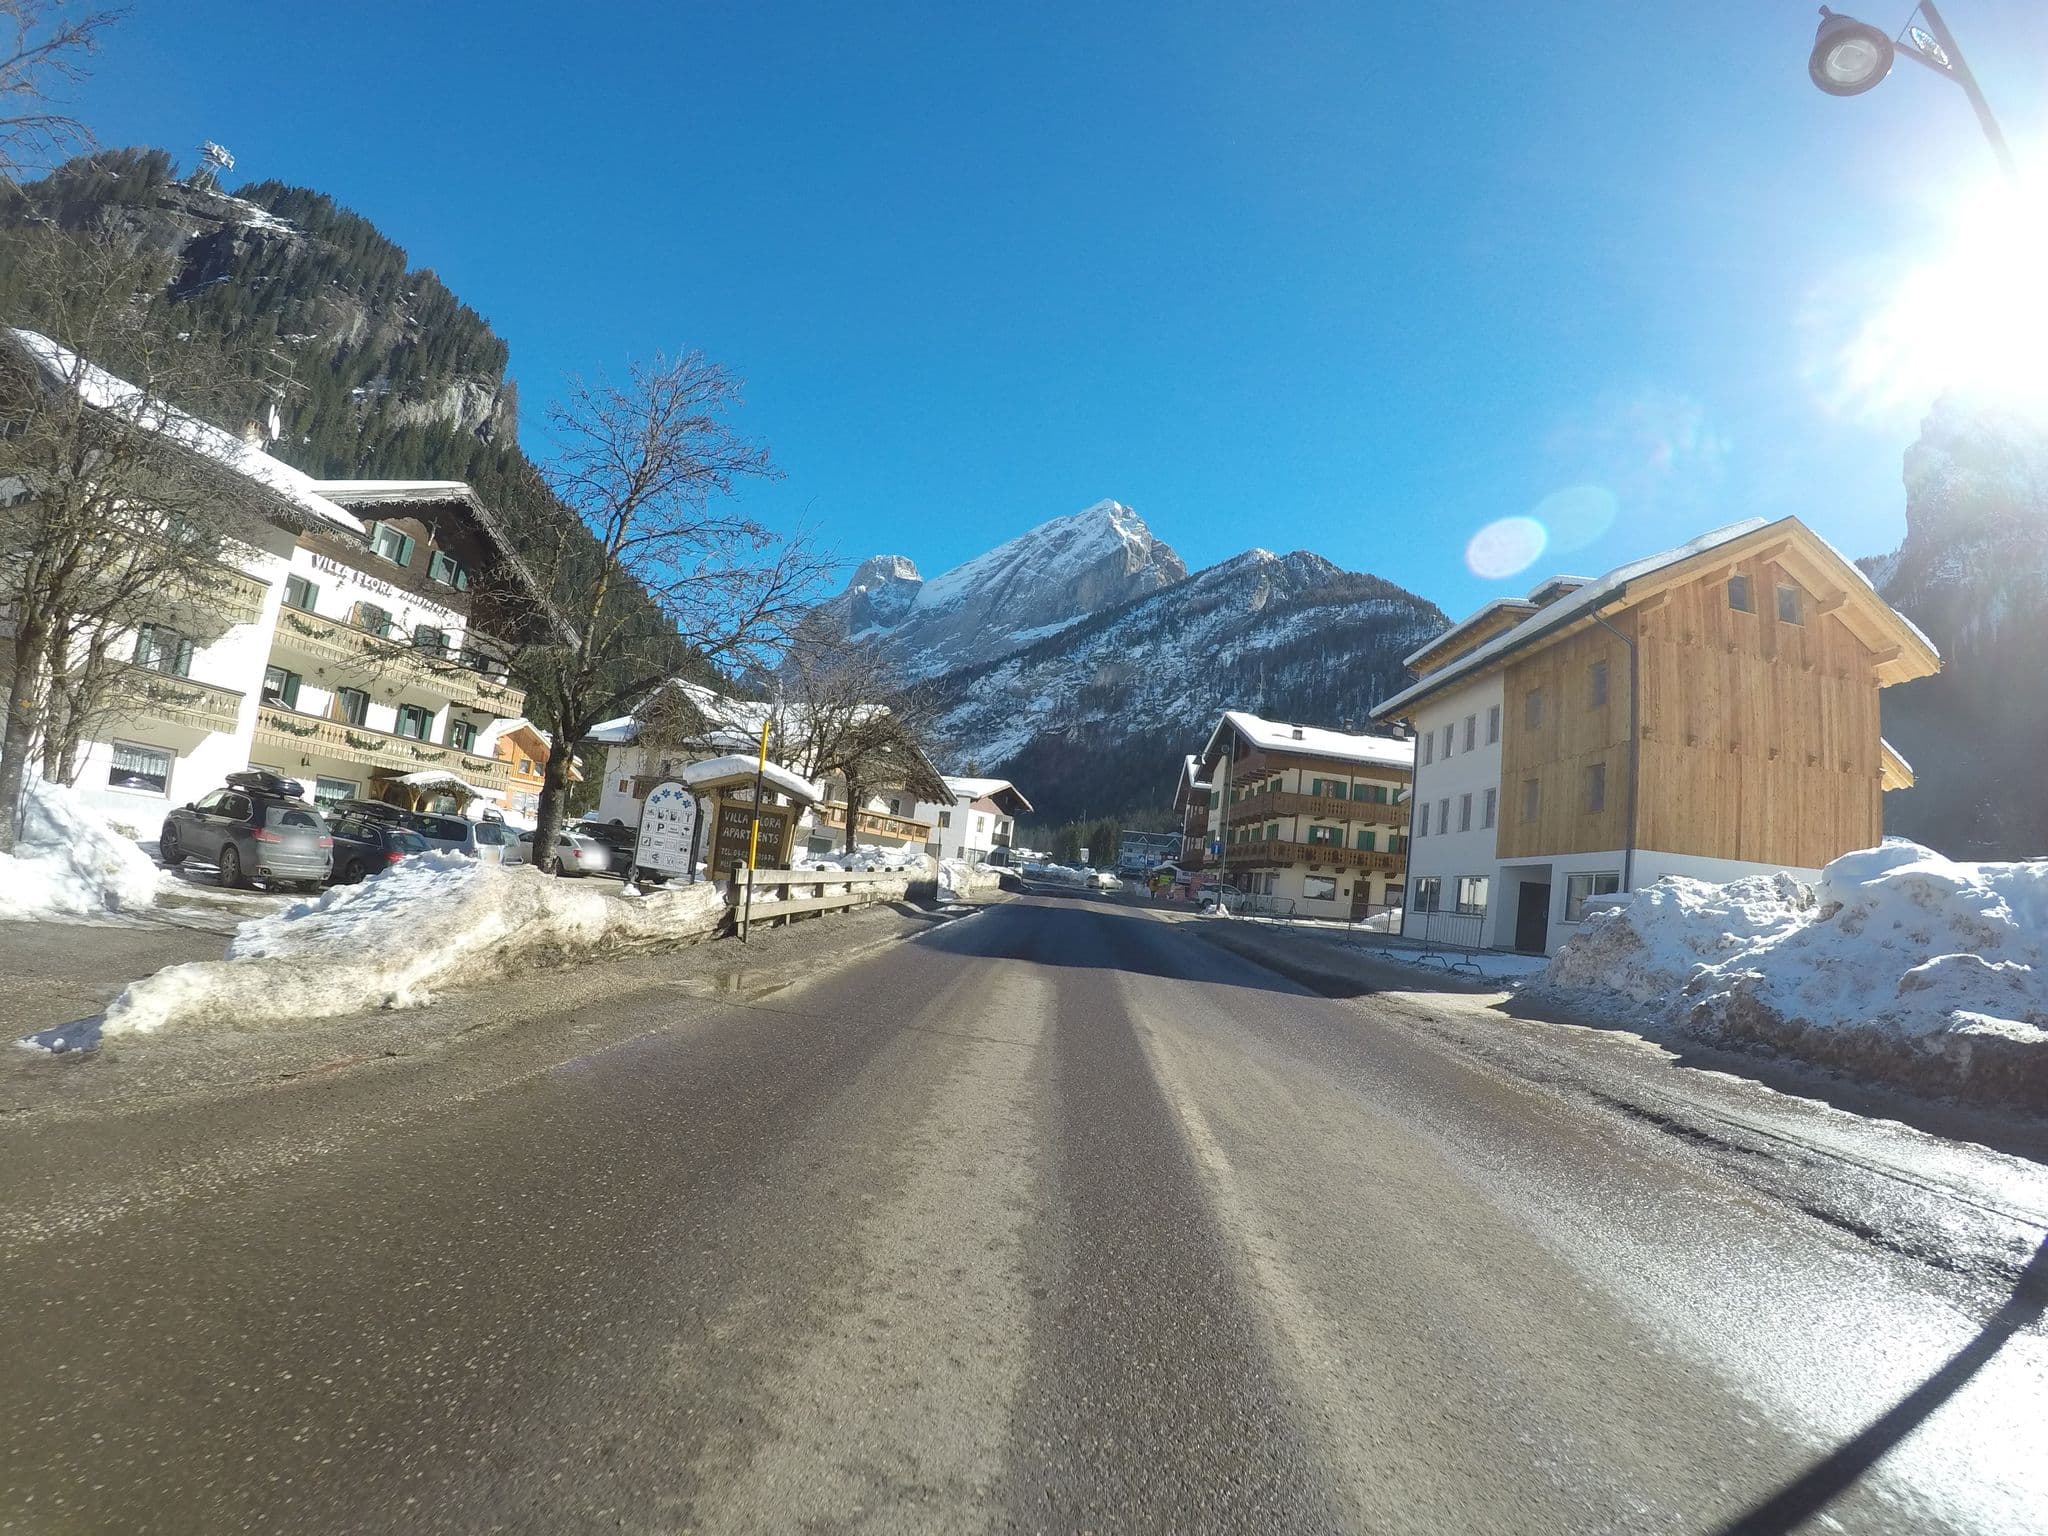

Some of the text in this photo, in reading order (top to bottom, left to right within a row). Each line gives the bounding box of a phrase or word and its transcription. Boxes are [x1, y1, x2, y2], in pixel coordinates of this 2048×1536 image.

[313, 553, 350, 580] VILLA
[354, 570, 396, 598] FLORA
[656, 823, 665, 832] P
[724, 810, 781, 829] VILLA LORA
[722, 826, 780, 844] APARTENTS
